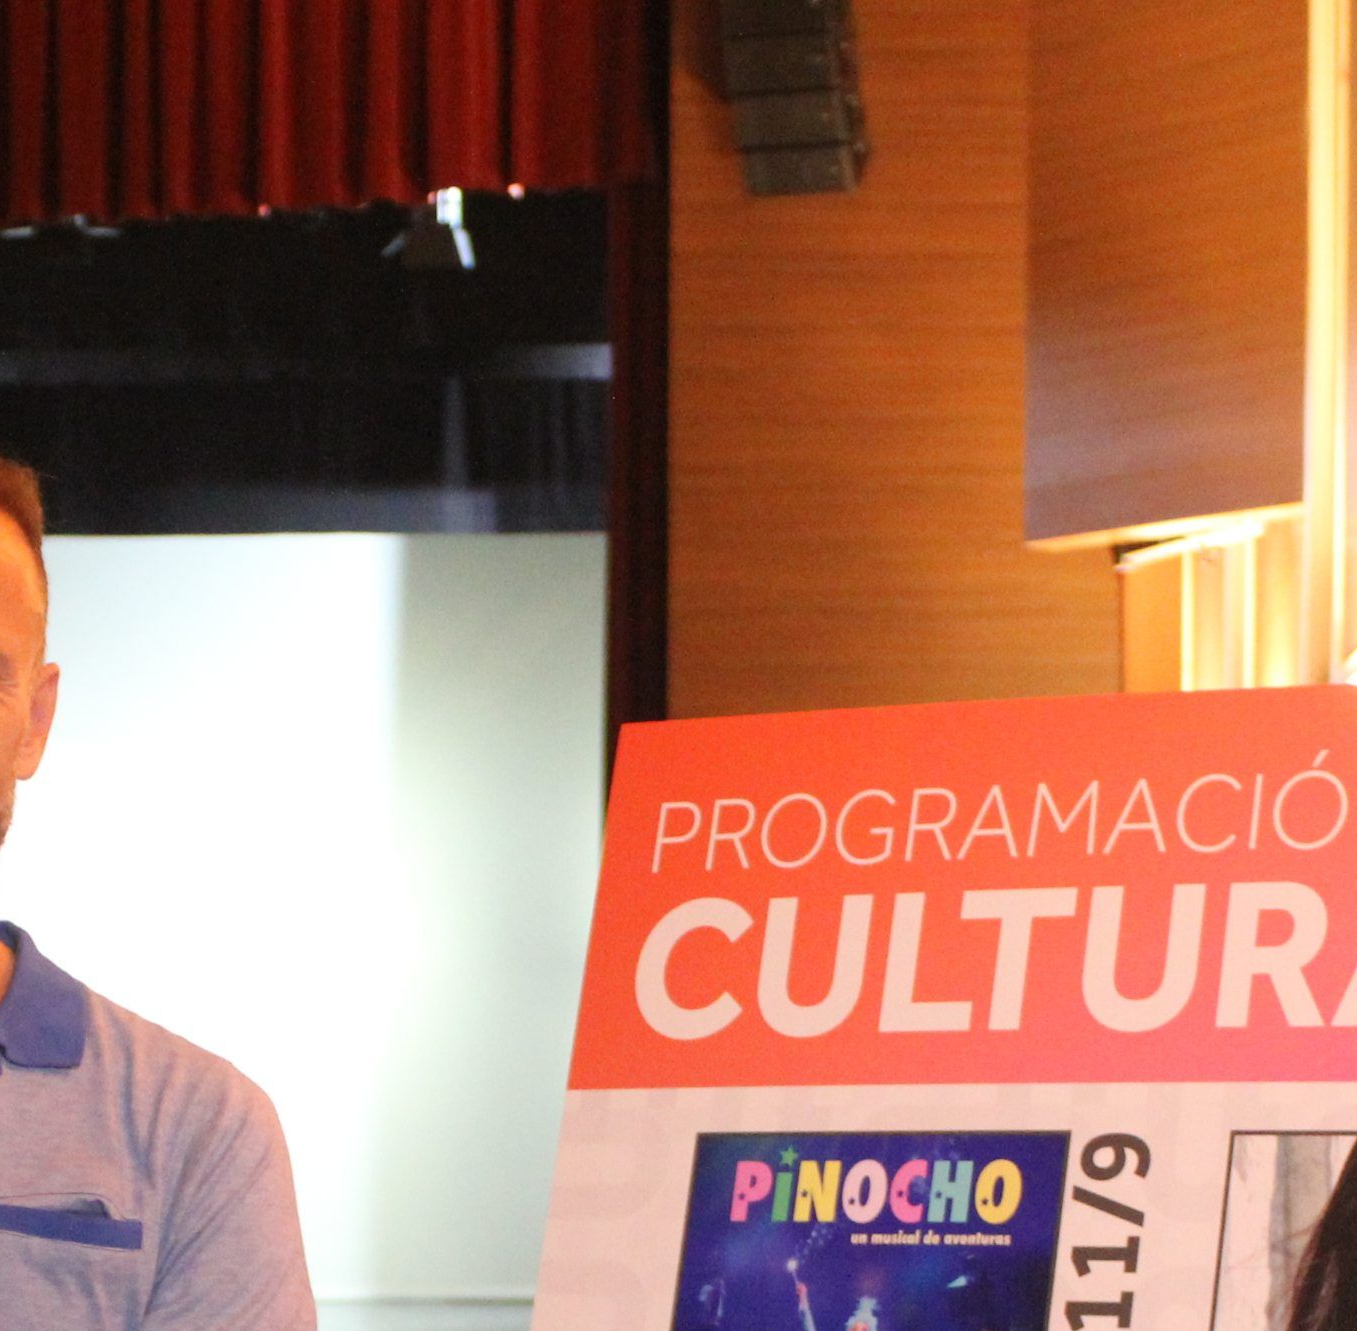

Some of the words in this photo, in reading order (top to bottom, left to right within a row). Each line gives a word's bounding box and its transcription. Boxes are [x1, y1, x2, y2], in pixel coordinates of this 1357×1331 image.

[651, 749, 1349, 874] PROGRAMACIÓ
[850, 1232, 868, 1245] un
[871, 1229, 921, 1246] musical
[1063, 1131, 1152, 1331] 11/9
